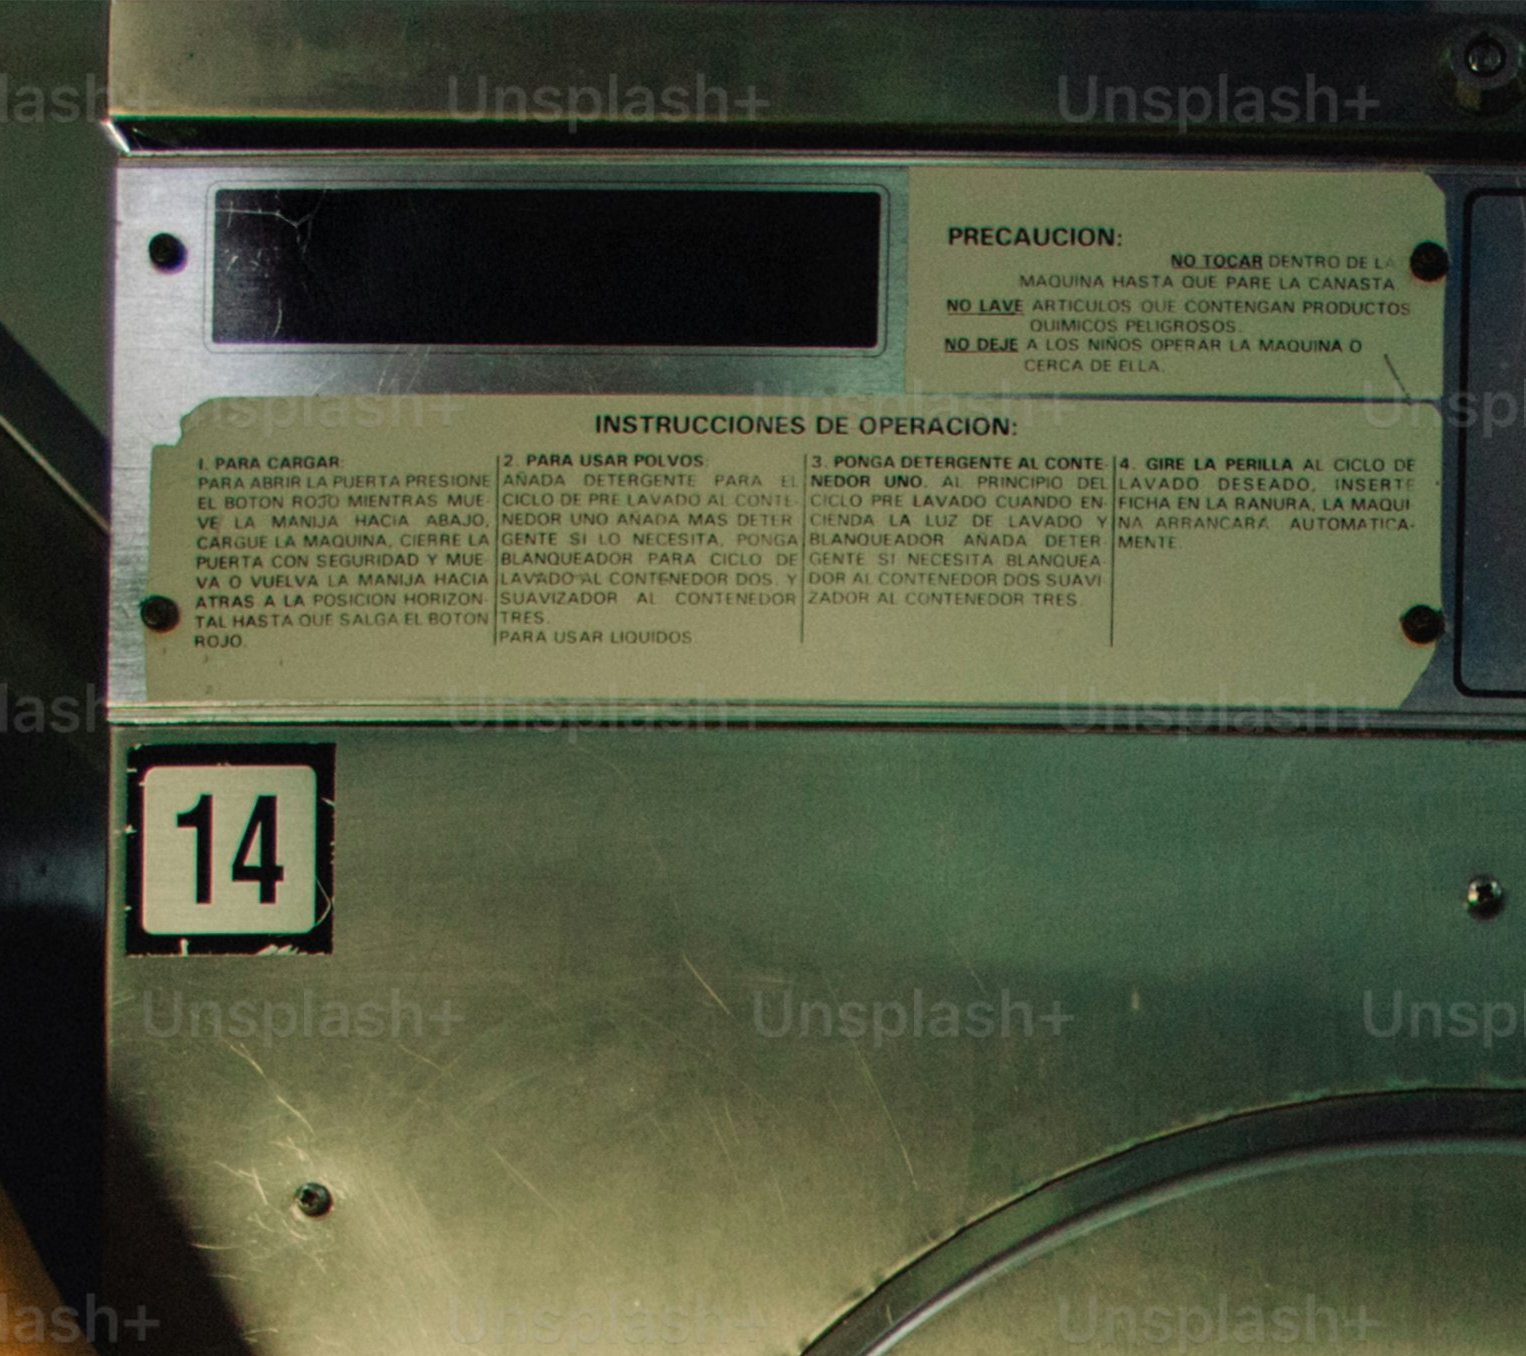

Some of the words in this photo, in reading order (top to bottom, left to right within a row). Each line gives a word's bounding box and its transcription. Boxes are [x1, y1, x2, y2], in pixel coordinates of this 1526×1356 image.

[947, 226, 1124, 247] PRECAUCION:
[1170, 253, 1196, 269] NO
[1203, 253, 1263, 270] TOCAR
[1268, 253, 1340, 268] DENTRO
[1346, 255, 1366, 269] DE
[1018, 274, 1104, 288] MAQUINA
[1111, 273, 1174, 289] HASTA
[1180, 274, 1216, 289] QUE
[1225, 274, 1271, 290] PARE
[1278, 276, 1301, 290] LA
[946, 298, 974, 316] NO
[976, 298, 1022, 316] LAVE
[1031, 298, 1132, 313] ARTICULOS
[1140, 299, 1174, 313] QUE
[1183, 299, 1295, 314] CONTENGAN
[1302, 299, 1410, 315] PRODUCTOS
[1029, 317, 1118, 333] QUIMICOS
[944, 336, 970, 353] NO
[976, 336, 1018, 353] DEJE
[1026, 337, 1038, 350] A
[1045, 337, 1079, 351] LOS
[1087, 335, 1142, 351] NIÑOS
[1150, 337, 1221, 352] OPERAR
[1228, 338, 1251, 352] LA
[1258, 338, 1343, 353] MAQUINA
[1348, 338, 1362, 353] O
[1023, 358, 1084, 372] CERCA
[1089, 358, 1111, 373] DE
[594, 414, 806, 434] INSTRUCCIONES
[815, 415, 848, 435] DE
[858, 415, 1018, 436] OPERACION:
[214, 456, 261, 470] PARA
[525, 453, 573, 467] PARA
[579, 453, 628, 467] USAR
[832, 454, 895, 468] PONGA
[900, 455, 1012, 470] DETERGENTE
[1016, 456, 1038, 470] AL
[1144, 456, 1184, 471] GIRE
[1193, 457, 1216, 471] LA
[1224, 457, 1293, 471] PERILLA
[1302, 457, 1321, 471] AL
[1332, 457, 1385, 472] CICLO
[1393, 458, 1414, 472] DE
[196, 475, 245, 490] PARA
[249, 474, 301, 490] ABRIR
[306, 475, 328, 489] LA
[332, 474, 400, 489] PUERTA
[404, 472, 489, 488] PRESIONE
[810, 473, 870, 488] NEDOR
[1118, 475, 1199, 491] LAVADO
[1217, 476, 1316, 493] DESEADO,
[196, 495, 216, 511] EL
[223, 495, 284, 510] BOTON
[291, 493, 340, 509] ROJO
[346, 493, 438, 508] MIENTRAS
[1118, 495, 1171, 510] FICHA
[1176, 495, 1200, 510] EN
[1205, 496, 1228, 510] LA
[1234, 496, 1315, 512] RANURA,
[1322, 496, 1344, 511] LA
[196, 514, 219, 530] VE
[234, 515, 255, 530] LA
[270, 514, 338, 529] MANIJA
[354, 512, 409, 528] HACIA
[1117, 515, 1143, 529] NA
[195, 534, 267, 550] CARGUE
[274, 534, 296, 549] LA
[399, 532, 460, 547] CIERRE
[467, 532, 490, 547] LA
[195, 554, 263, 570] PUERTA
[270, 554, 309, 569] CON
[316, 552, 420, 568] SEGURIDAD
[426, 552, 438, 566] Y
[195, 574, 220, 589] VA
[228, 574, 242, 589] O
[249, 573, 319, 589] VUELVA
[327, 573, 348, 587] LA
[357, 572, 426, 587] MANIJA
[433, 571, 489, 586] HACIA
[194, 593, 254, 609] ATRAS
[263, 593, 276, 607] A
[282, 593, 305, 608] LA
[312, 592, 396, 607] POSICION
[194, 614, 226, 629] TAL
[231, 613, 294, 628] HASTA
[298, 612, 332, 627] QUE
[338, 611, 398, 626] SALGA
[403, 611, 420, 626] EL
[427, 611, 489, 626] BOTON
[176, 793, 286, 905] 14
